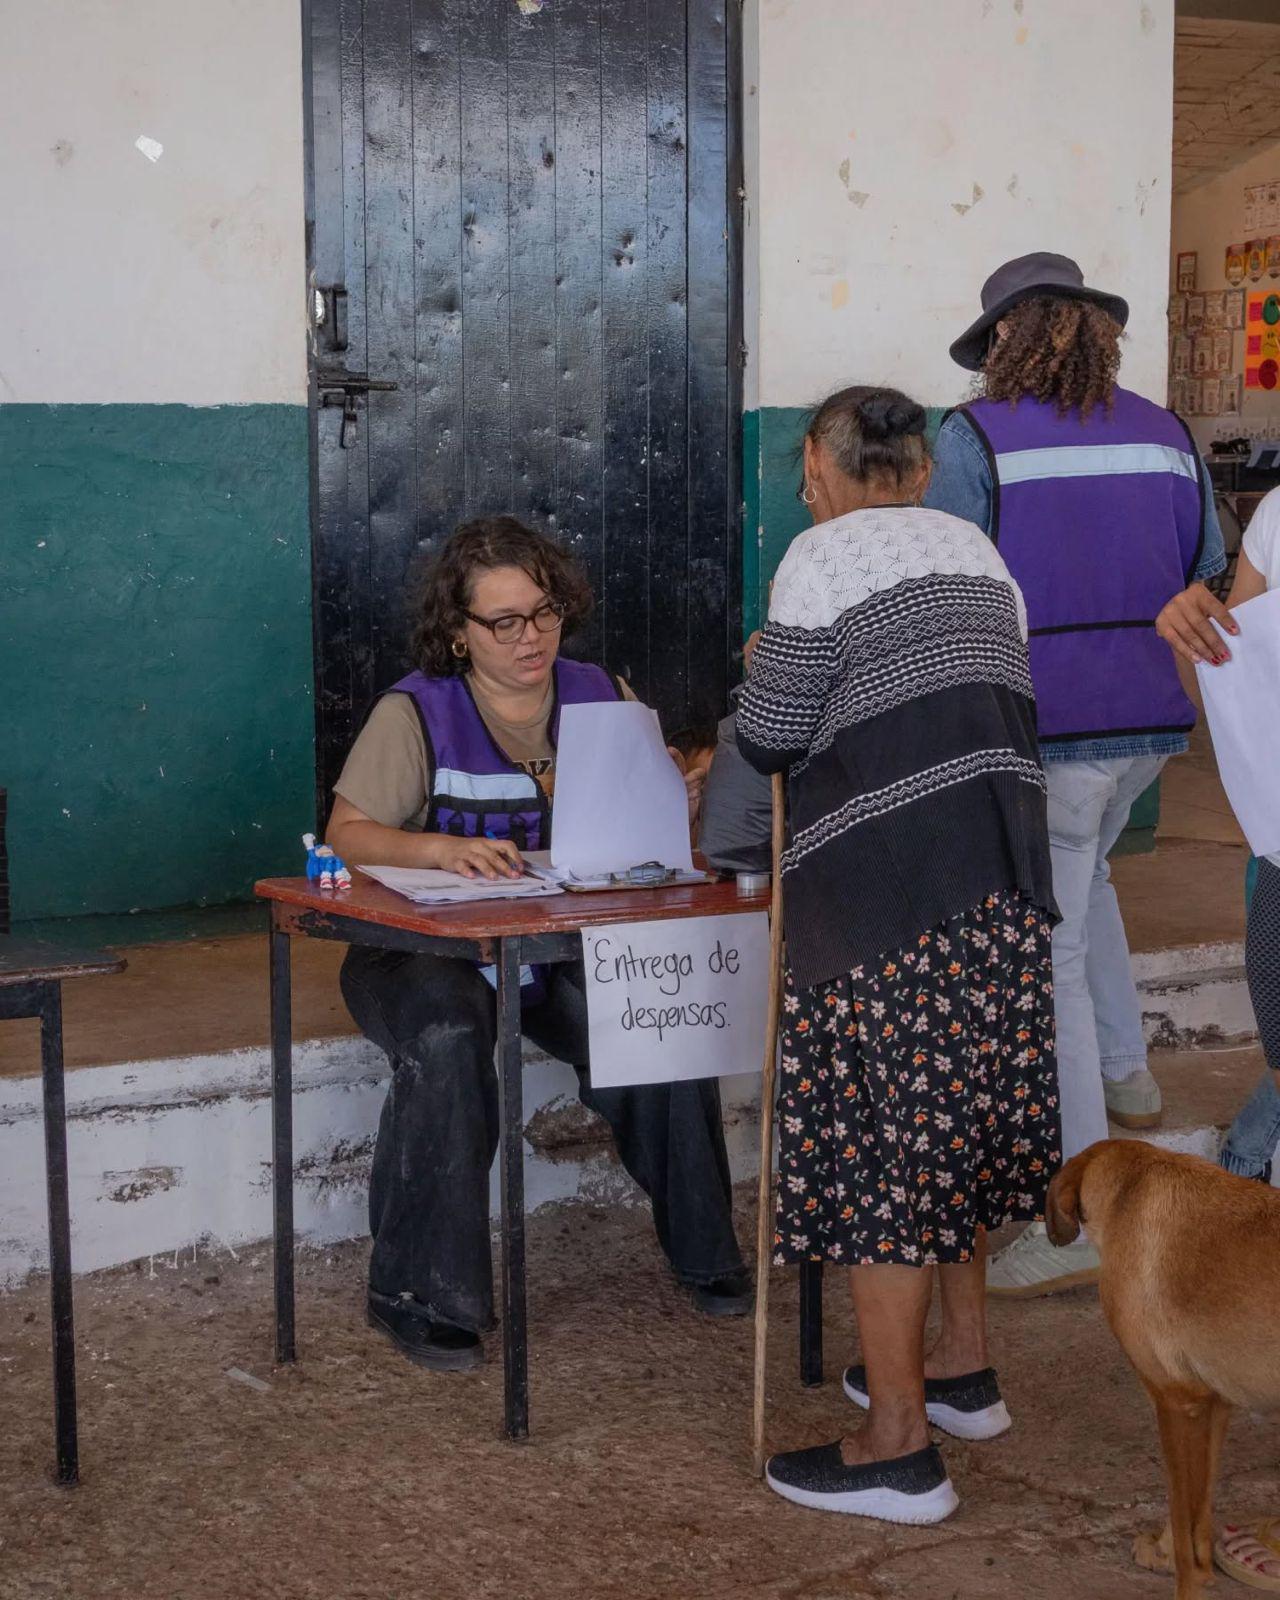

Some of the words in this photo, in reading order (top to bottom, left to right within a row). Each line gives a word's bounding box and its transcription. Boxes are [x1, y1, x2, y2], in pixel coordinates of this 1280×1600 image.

[594, 938, 694, 995] Entrega
[708, 940, 740, 974] de
[621, 997, 731, 1041] despensas.
